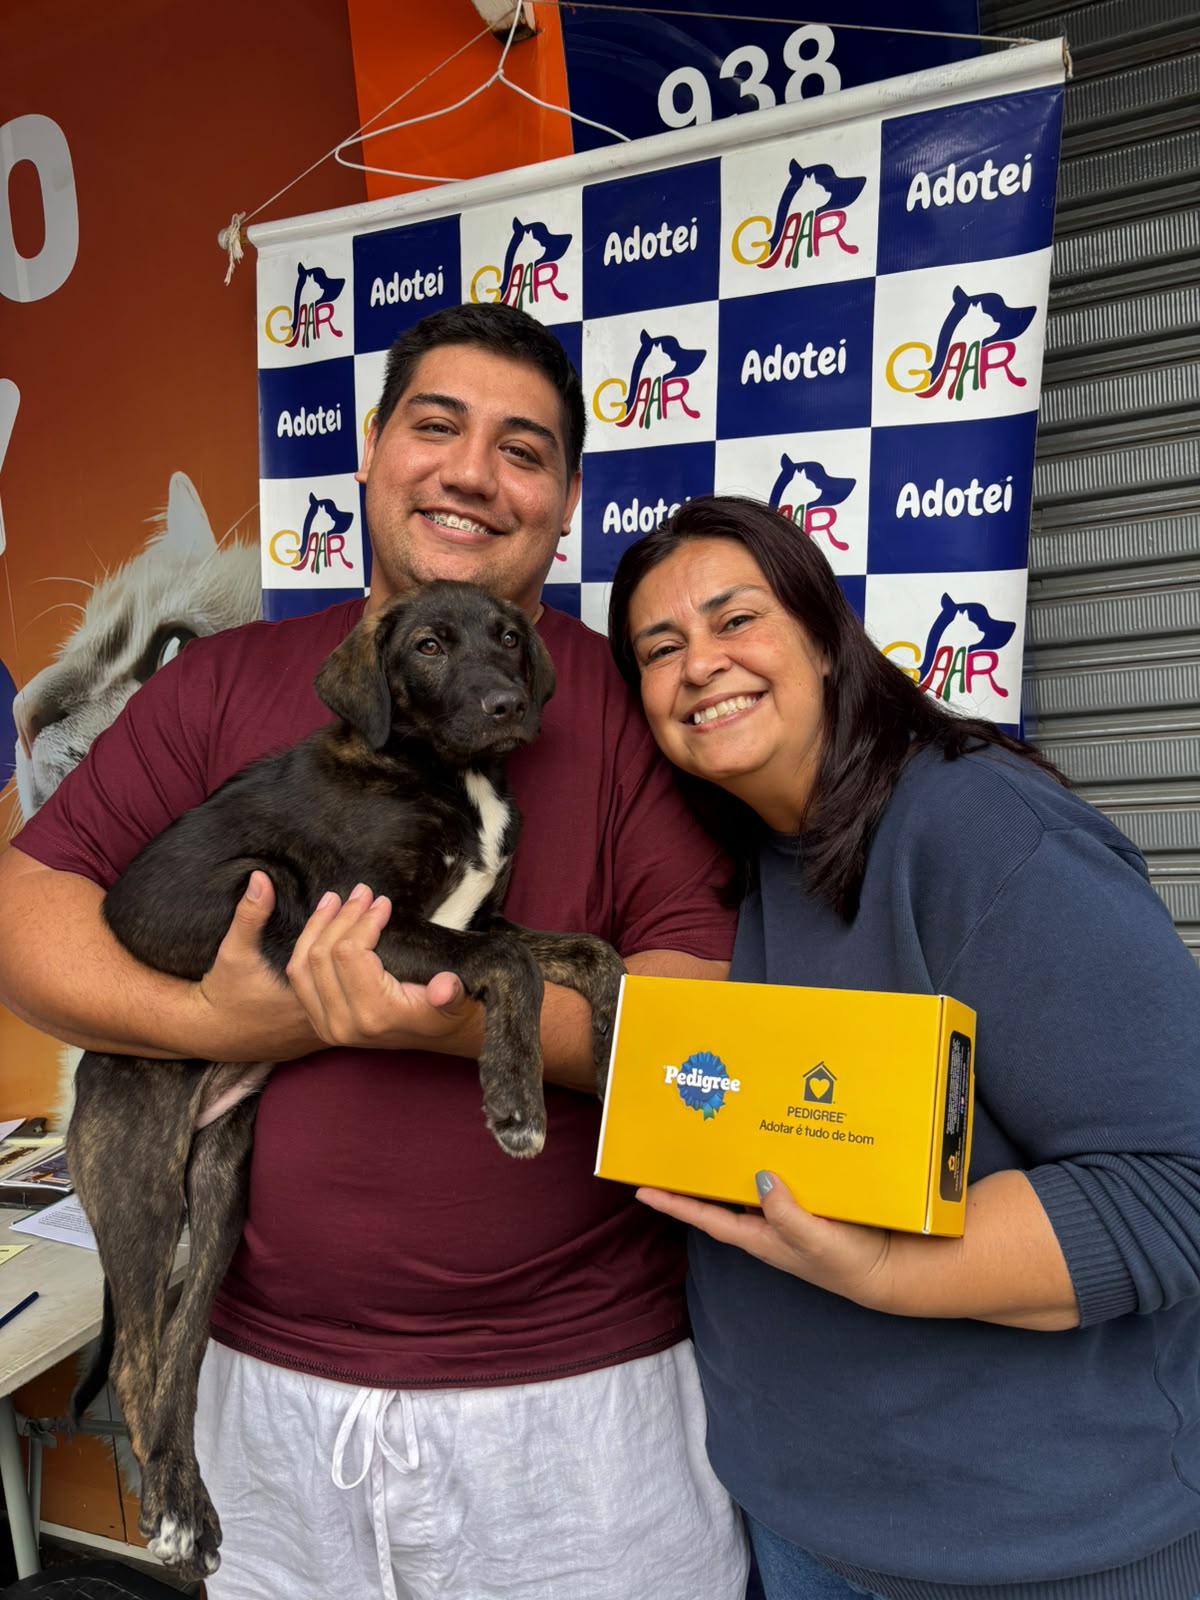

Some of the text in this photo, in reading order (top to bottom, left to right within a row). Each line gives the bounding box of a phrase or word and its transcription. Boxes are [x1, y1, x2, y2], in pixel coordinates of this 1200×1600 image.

[657, 23, 842, 128] 938
[906, 154, 1033, 212] Adotei
[603, 218, 698, 267] Adotei
[731, 210, 859, 269] GAAR
[370, 265, 444, 308] Adotei
[470, 262, 569, 311] GAAR
[265, 303, 343, 348] GAAR
[741, 338, 847, 385] Adotei
[885, 341, 1027, 401] GAAR
[277, 403, 342, 438] Adotei
[592, 377, 701, 429] GAAR
[602, 496, 691, 534] Adot
[895, 476, 1013, 519] Adotei
[269, 529, 354, 573] GAAR
[664, 1065, 741, 1093] Pedigree
[759, 1119, 875, 1145] Adotar é tudo de bom
[786, 1106, 844, 1123] PEDIGREE
